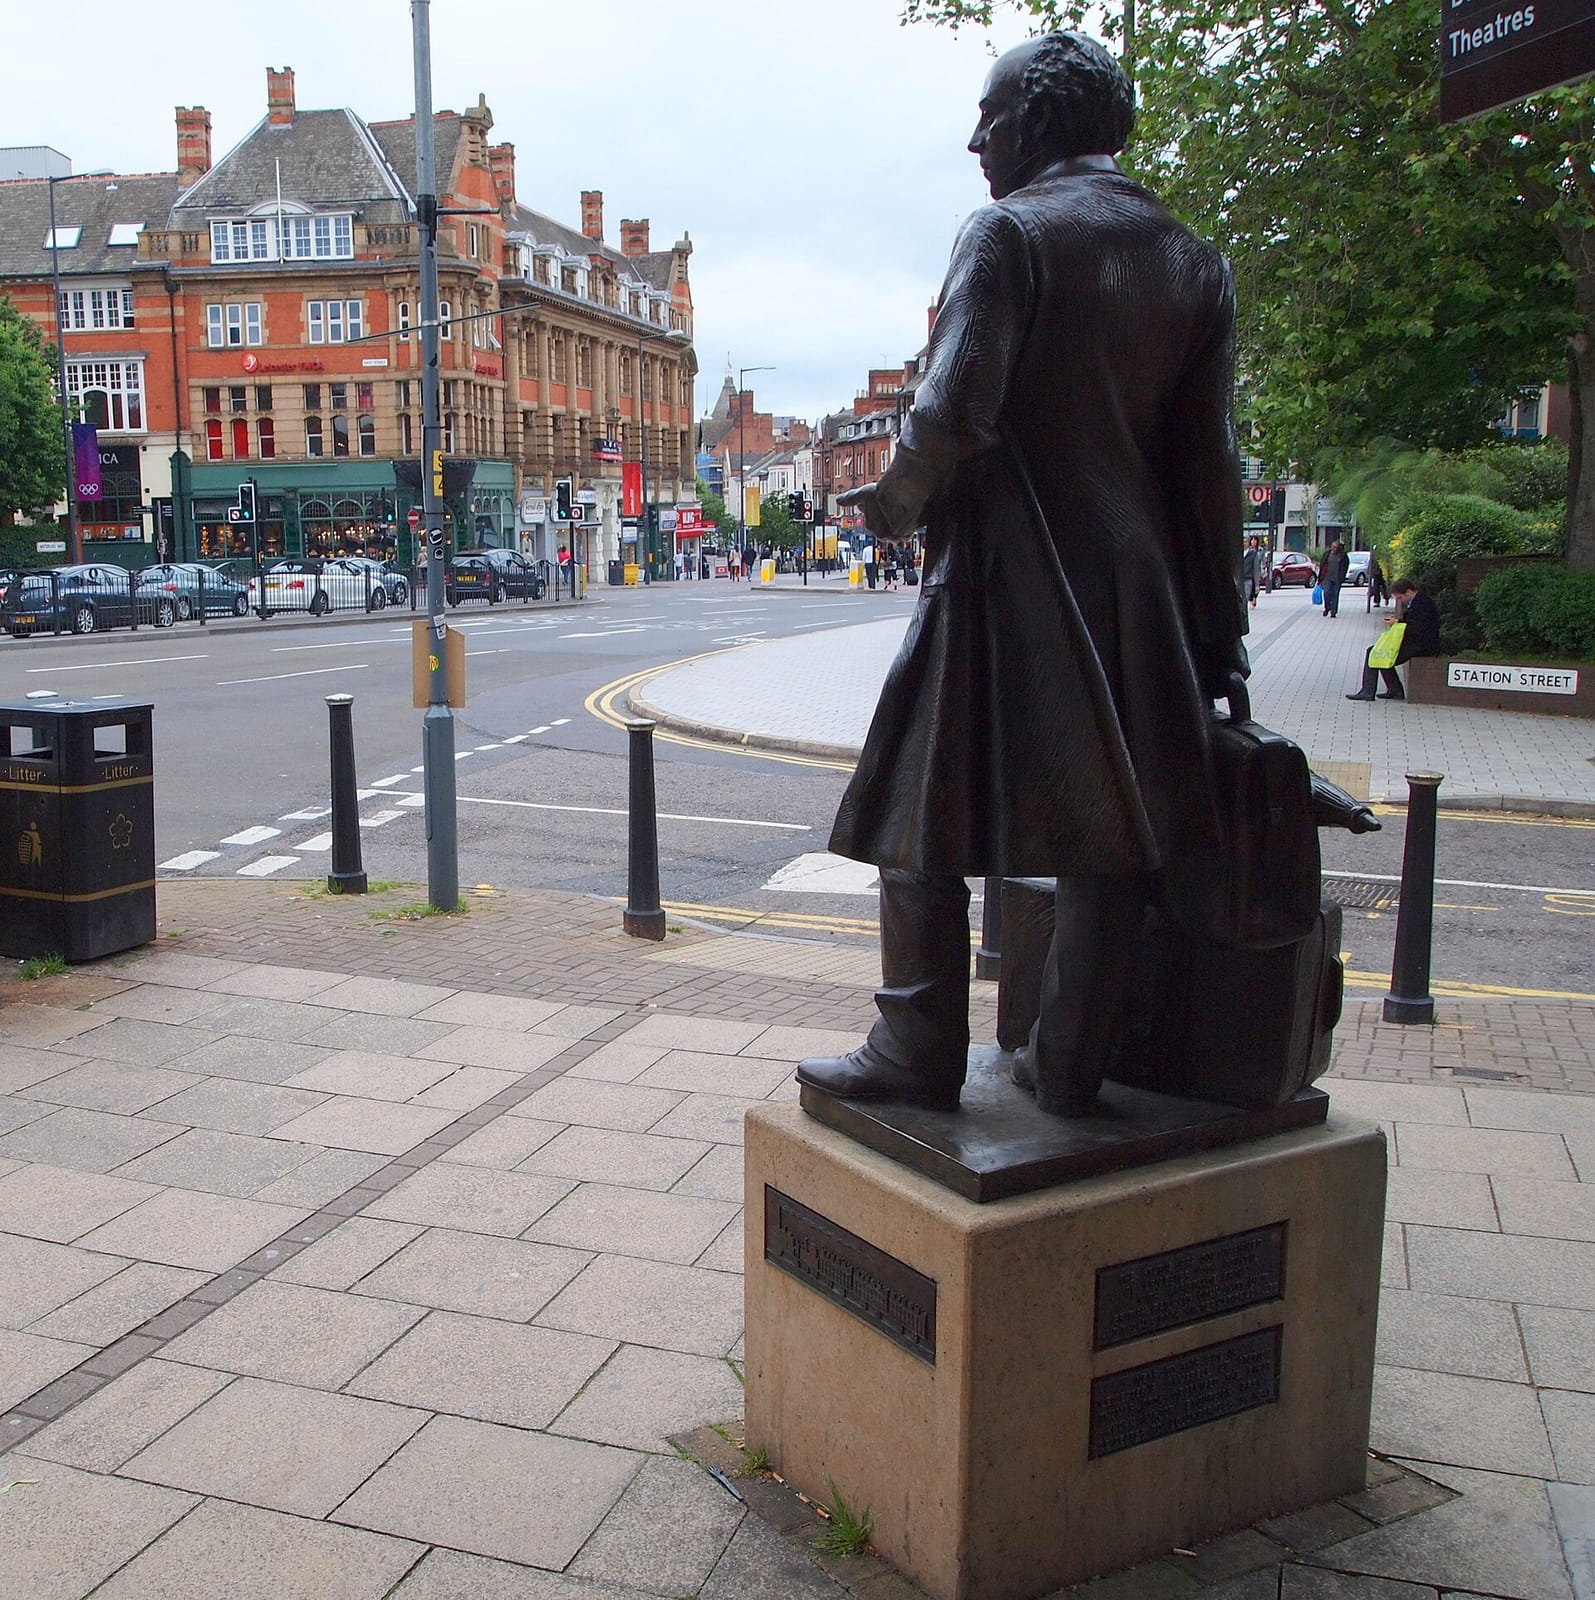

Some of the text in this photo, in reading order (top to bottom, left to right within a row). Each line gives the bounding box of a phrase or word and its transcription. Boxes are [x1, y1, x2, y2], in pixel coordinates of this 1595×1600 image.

[1449, 5, 1535, 57] Theatres
[98, 453, 119, 464] ICA
[1454, 669, 1571, 688] STATION STREET
[9, 766, 41, 781] Litter
[105, 765, 133, 779] Litter
